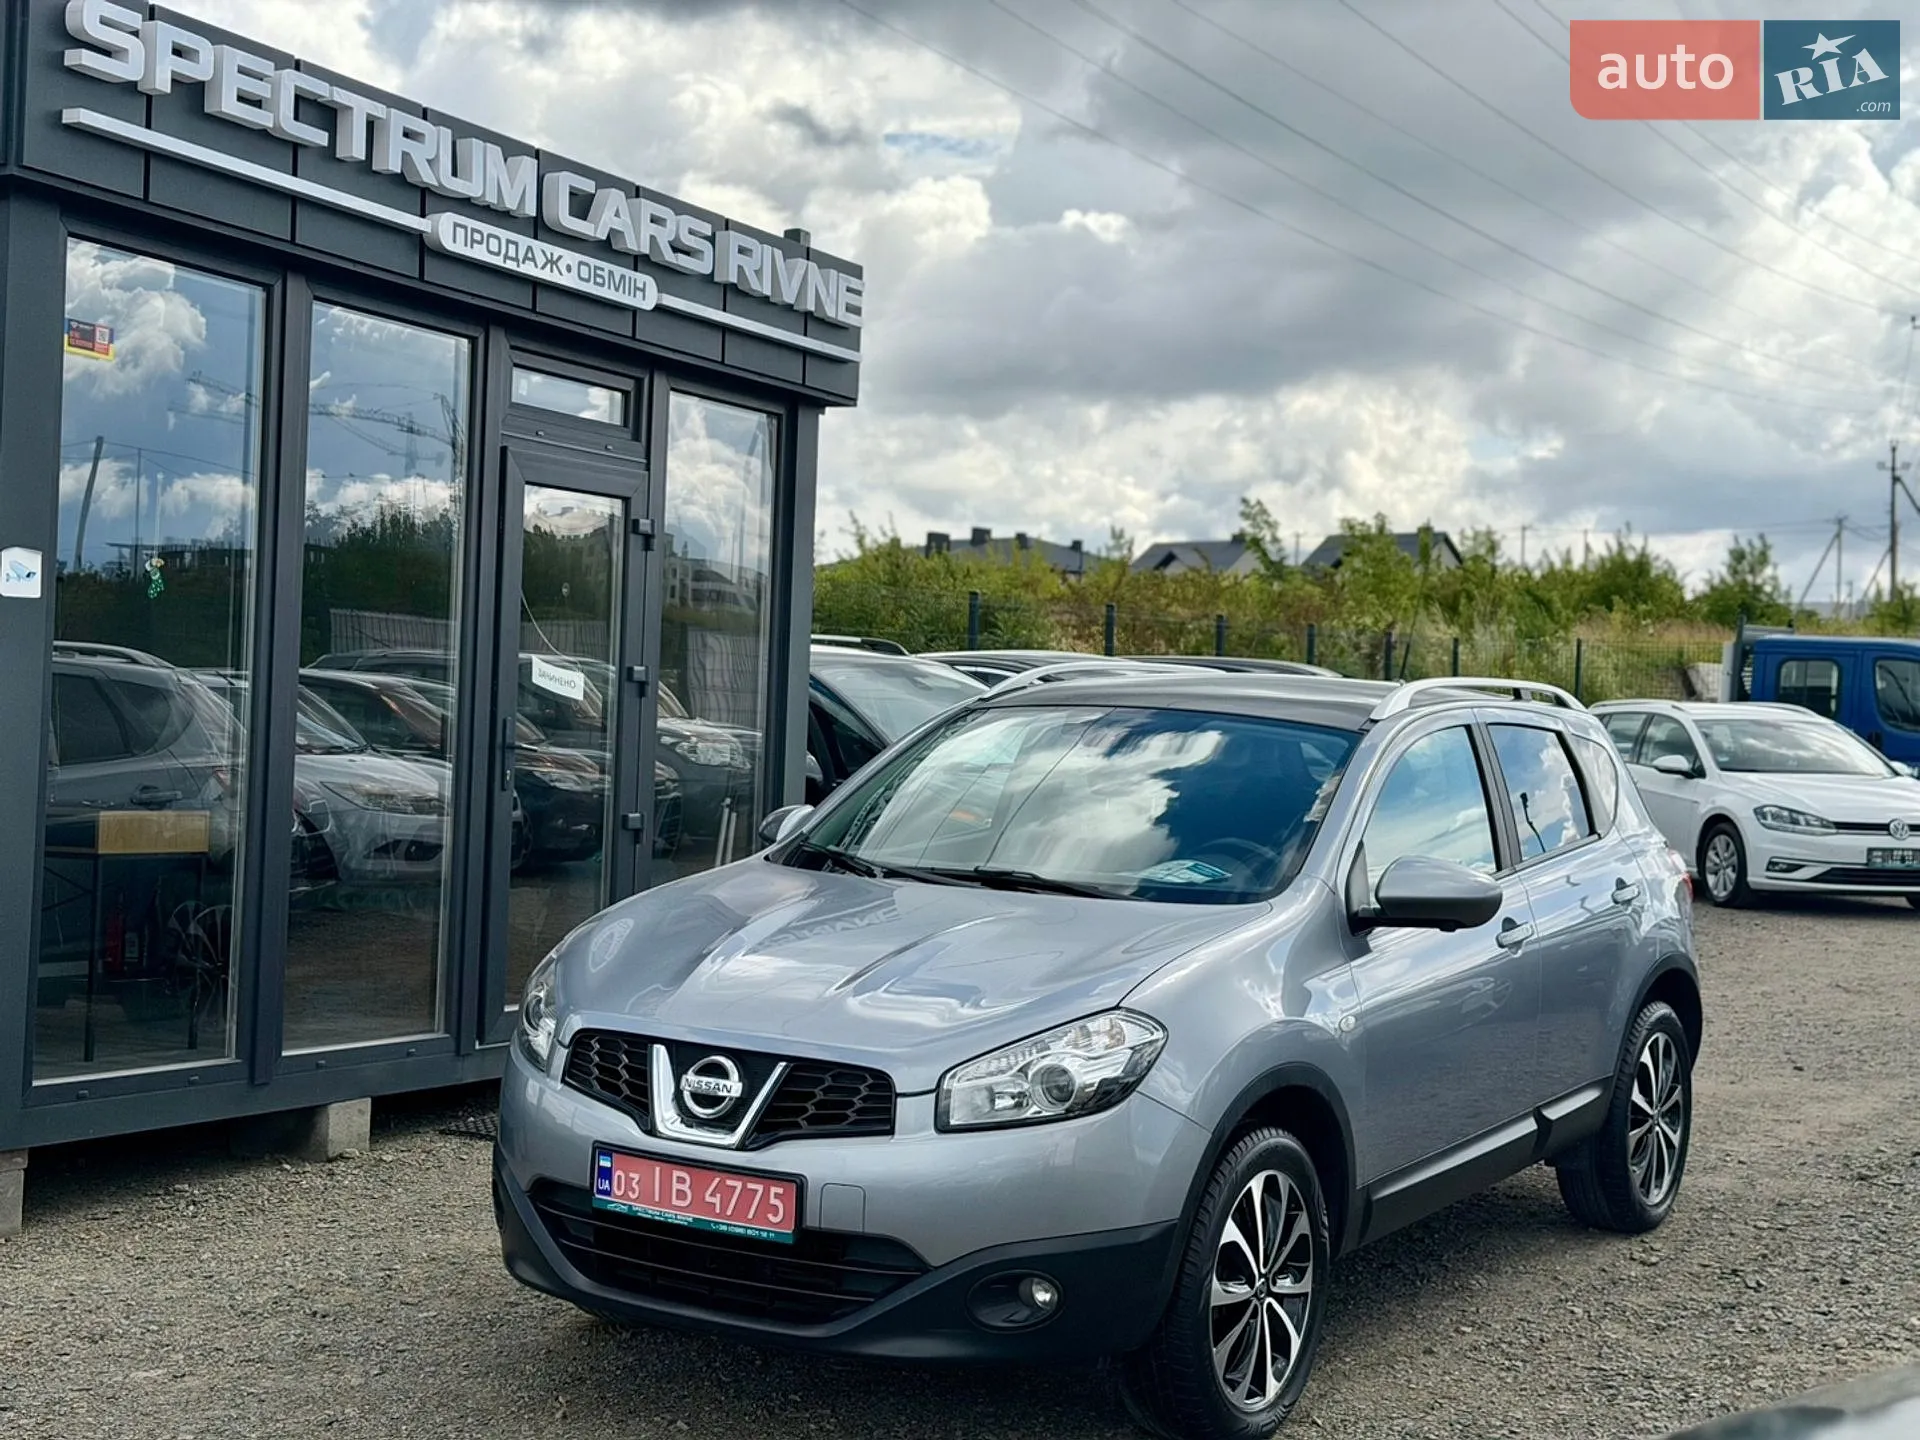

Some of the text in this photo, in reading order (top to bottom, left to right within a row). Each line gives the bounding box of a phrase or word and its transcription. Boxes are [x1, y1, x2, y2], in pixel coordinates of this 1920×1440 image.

[64, 0, 864, 328] SPECTRUM CARS RIVNE
[684, 1078, 732, 1094] NISSAN
[598, 1177, 610, 1192] UA
[613, 1169, 640, 1200] 03
[704, 1177, 785, 1224] 4775
